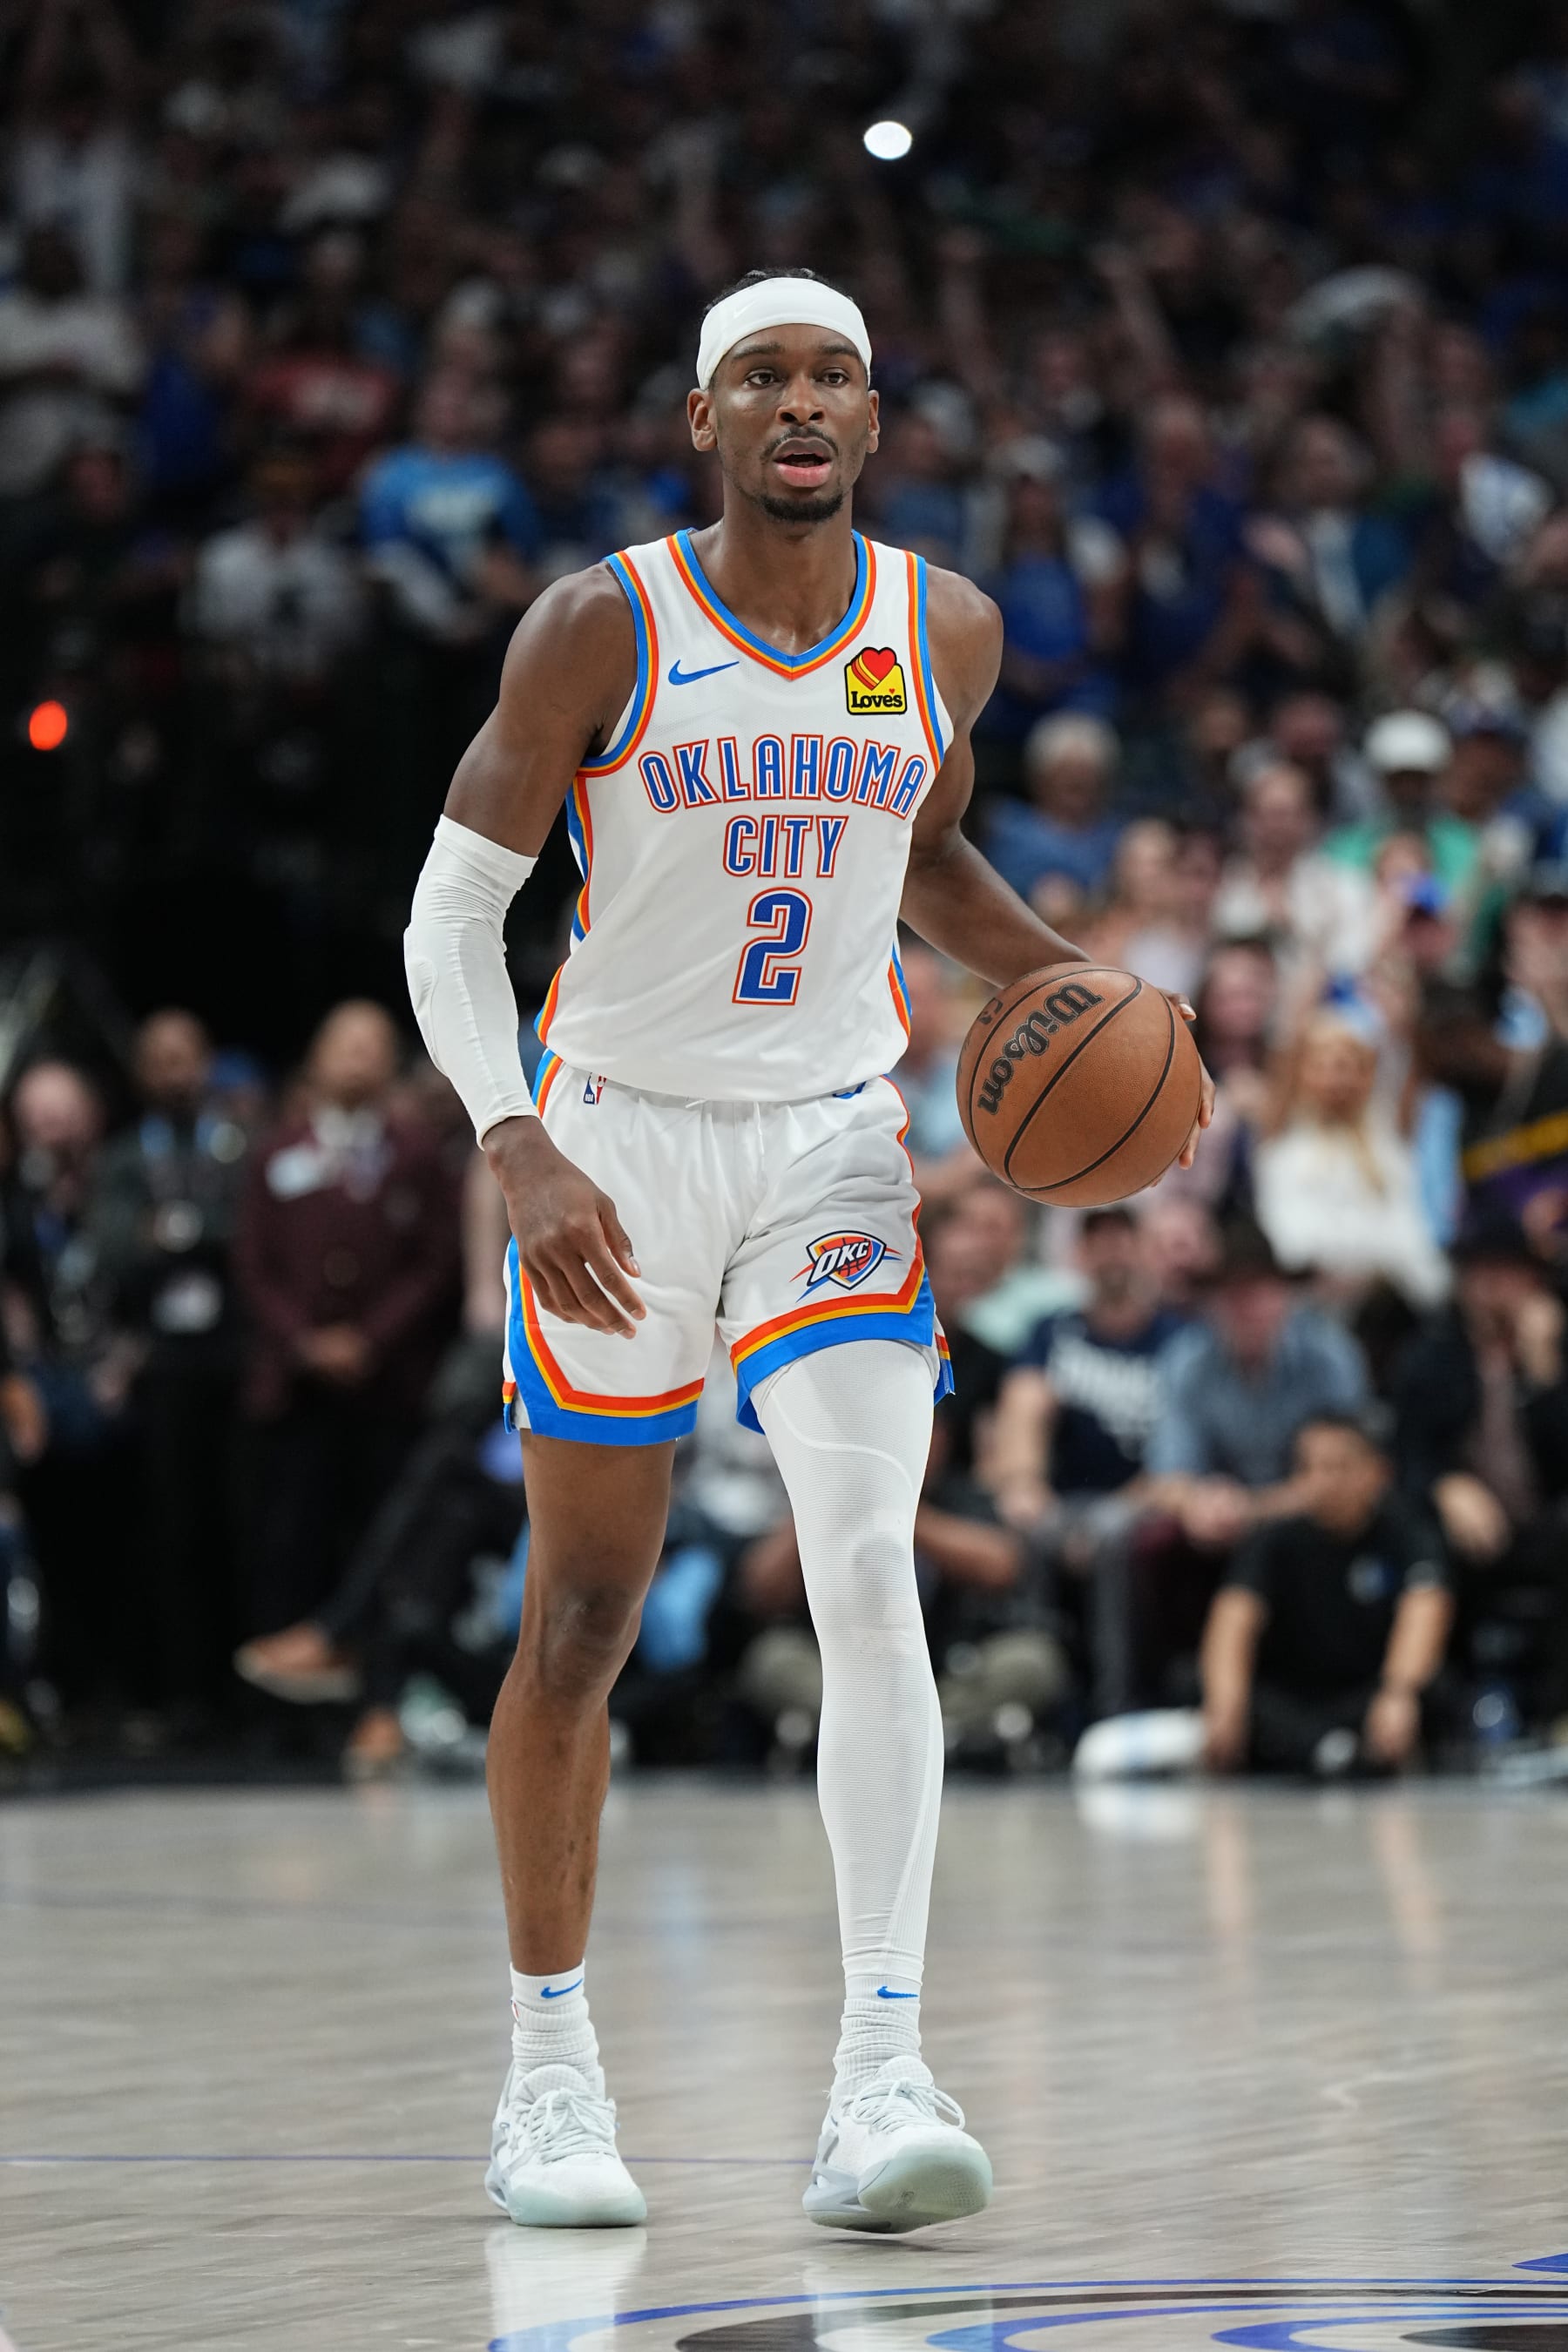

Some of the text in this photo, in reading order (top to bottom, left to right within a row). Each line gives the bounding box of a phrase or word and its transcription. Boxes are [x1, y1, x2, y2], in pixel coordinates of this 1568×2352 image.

[639, 734, 928, 820] OKLAHOMA
[723, 814, 849, 878] CITY
[732, 887, 813, 1005] 2
[977, 982, 1105, 1116] Wilson
[584, 1093, 594, 1103] NBA
[808, 1240, 870, 1285] OKC
